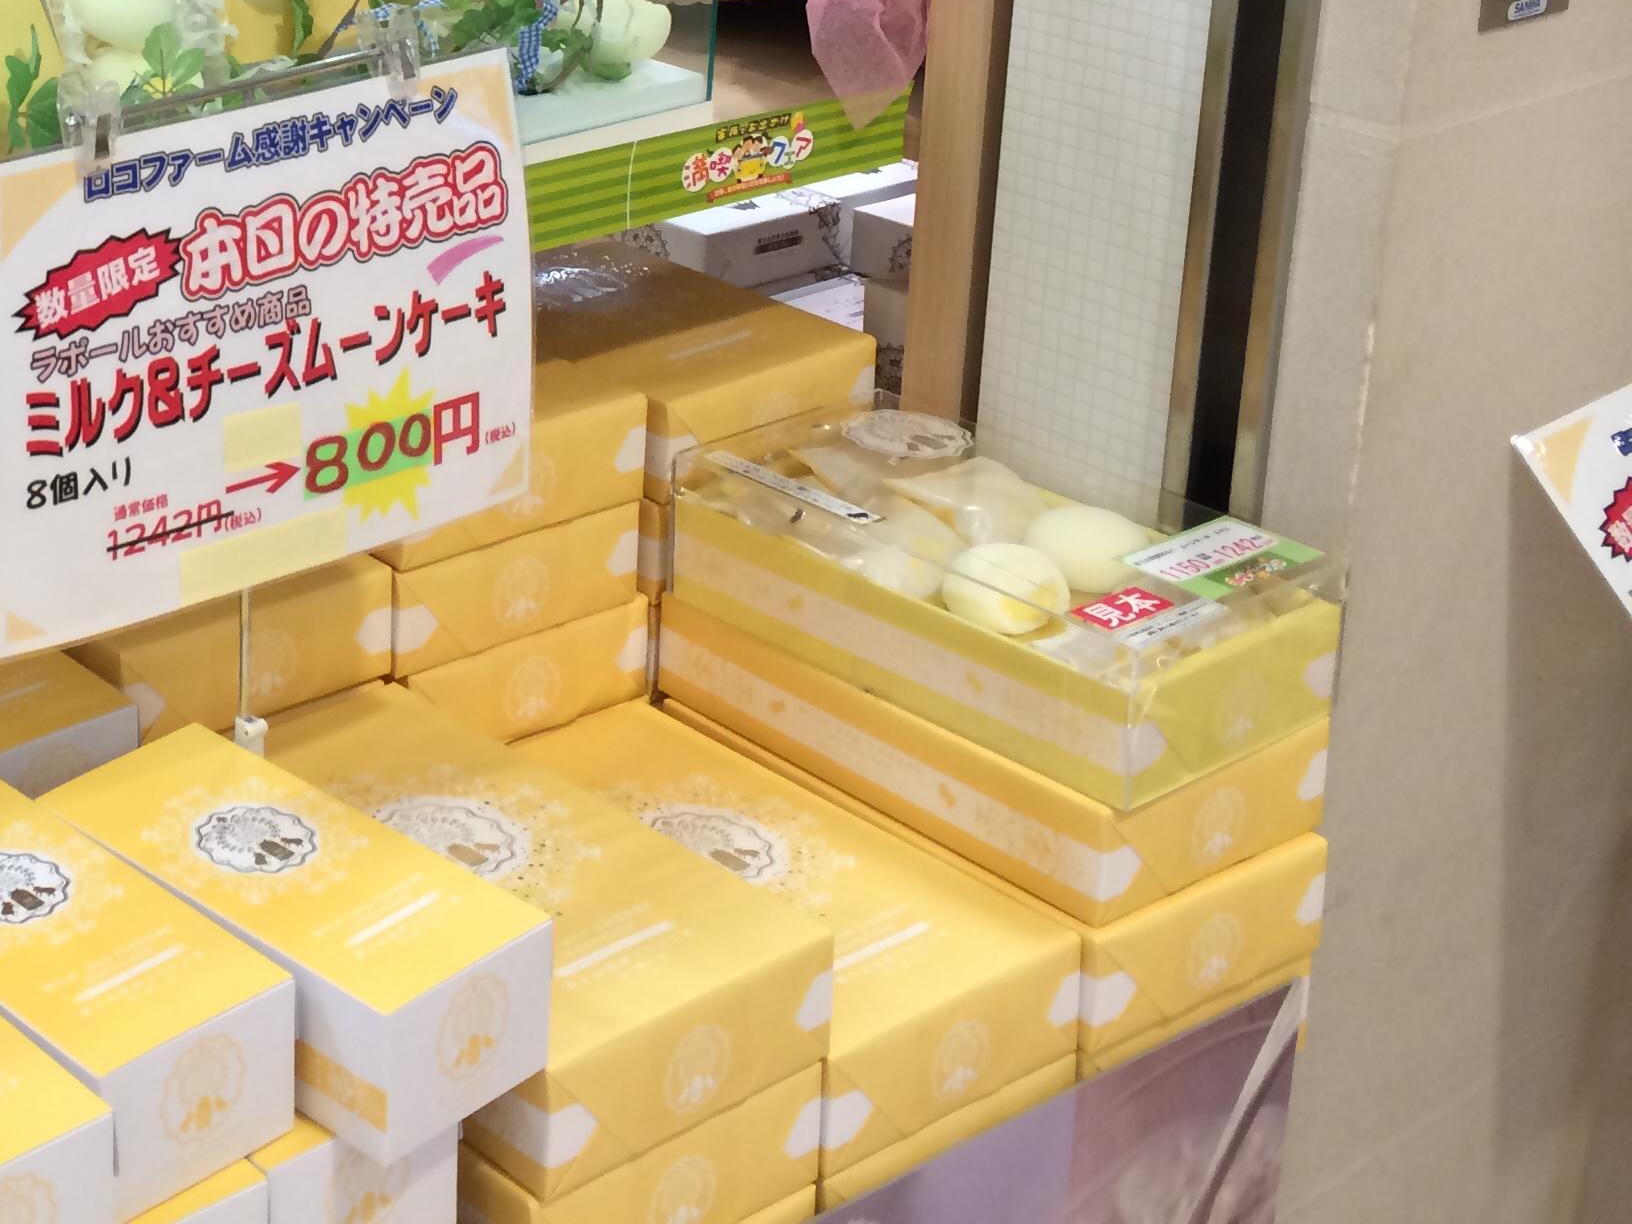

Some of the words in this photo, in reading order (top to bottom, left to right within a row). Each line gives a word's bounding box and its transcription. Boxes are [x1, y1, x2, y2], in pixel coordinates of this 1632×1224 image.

[84, 86, 458, 203] ロコファーム感謝キャンペーン
[184, 143, 506, 293] 本日の特売品
[34, 246, 162, 330] 数量限定
[24, 271, 507, 461] ミルク&チーズムーンケーキ
[30, 284, 312, 383] ラポールおすすめ商品
[305, 391, 480, 494] 800円
[485, 422, 516, 446] (税込)
[26, 456, 131, 510] 8個入り
[113, 493, 169, 522] 通常価格
[223, 508, 262, 532] (税込)
[1213, 536, 1261, 562] 1242
[1160, 558, 1211, 581] 1150
[1082, 591, 1161, 628] 見本
